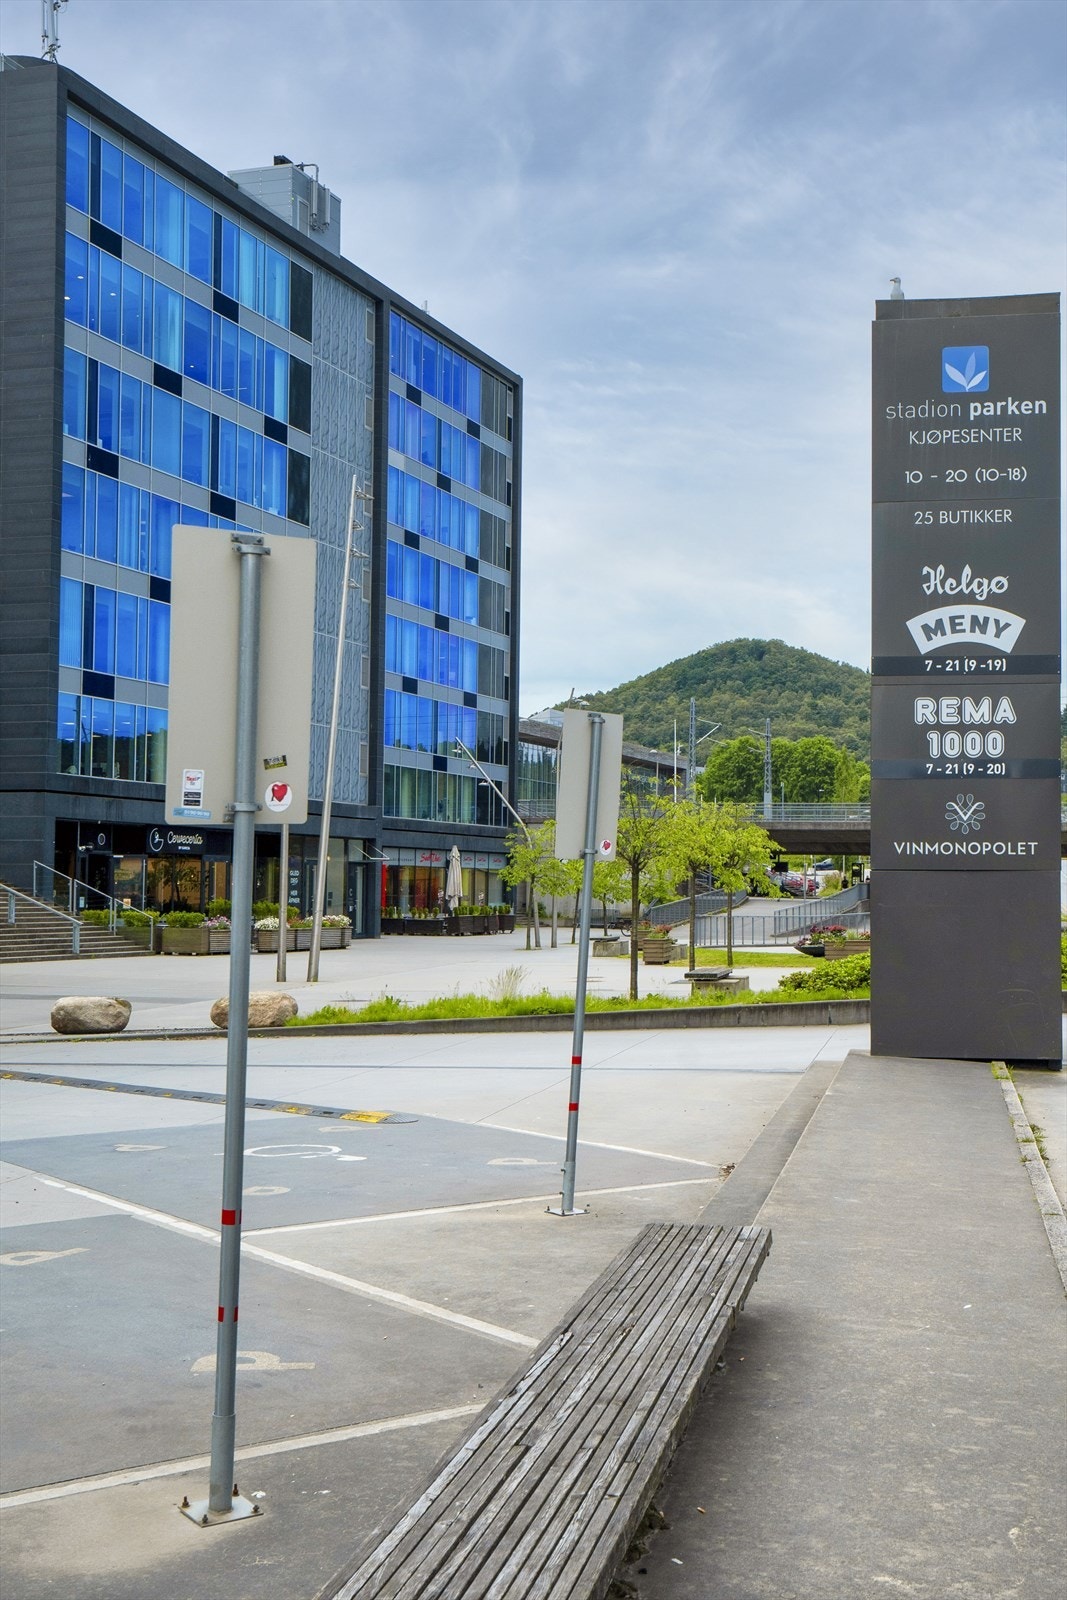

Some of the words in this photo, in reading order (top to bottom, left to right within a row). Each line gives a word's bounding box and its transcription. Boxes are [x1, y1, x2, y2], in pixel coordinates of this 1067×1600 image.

[886, 400, 961, 419] stadion
[969, 397, 1047, 420] parken
[909, 427, 1022, 445] KJØPESENTER
[905, 470, 923, 484] 10
[945, 470, 968, 483] 20
[975, 466, 1027, 483] (10-18)
[914, 511, 934, 525] 25
[939, 510, 1013, 524] BUTIKKER
[922, 563, 1009, 601] Helgø
[920, 614, 1012, 642] MENY
[924, 660, 933, 672] 7
[945, 659, 960, 672] 21
[915, 696, 1017, 725] REMA
[926, 730, 1005, 759] 1000
[925, 763, 934, 775] 7
[945, 763, 959, 775] 21
[893, 841, 1039, 855] VINMONOPOLET
